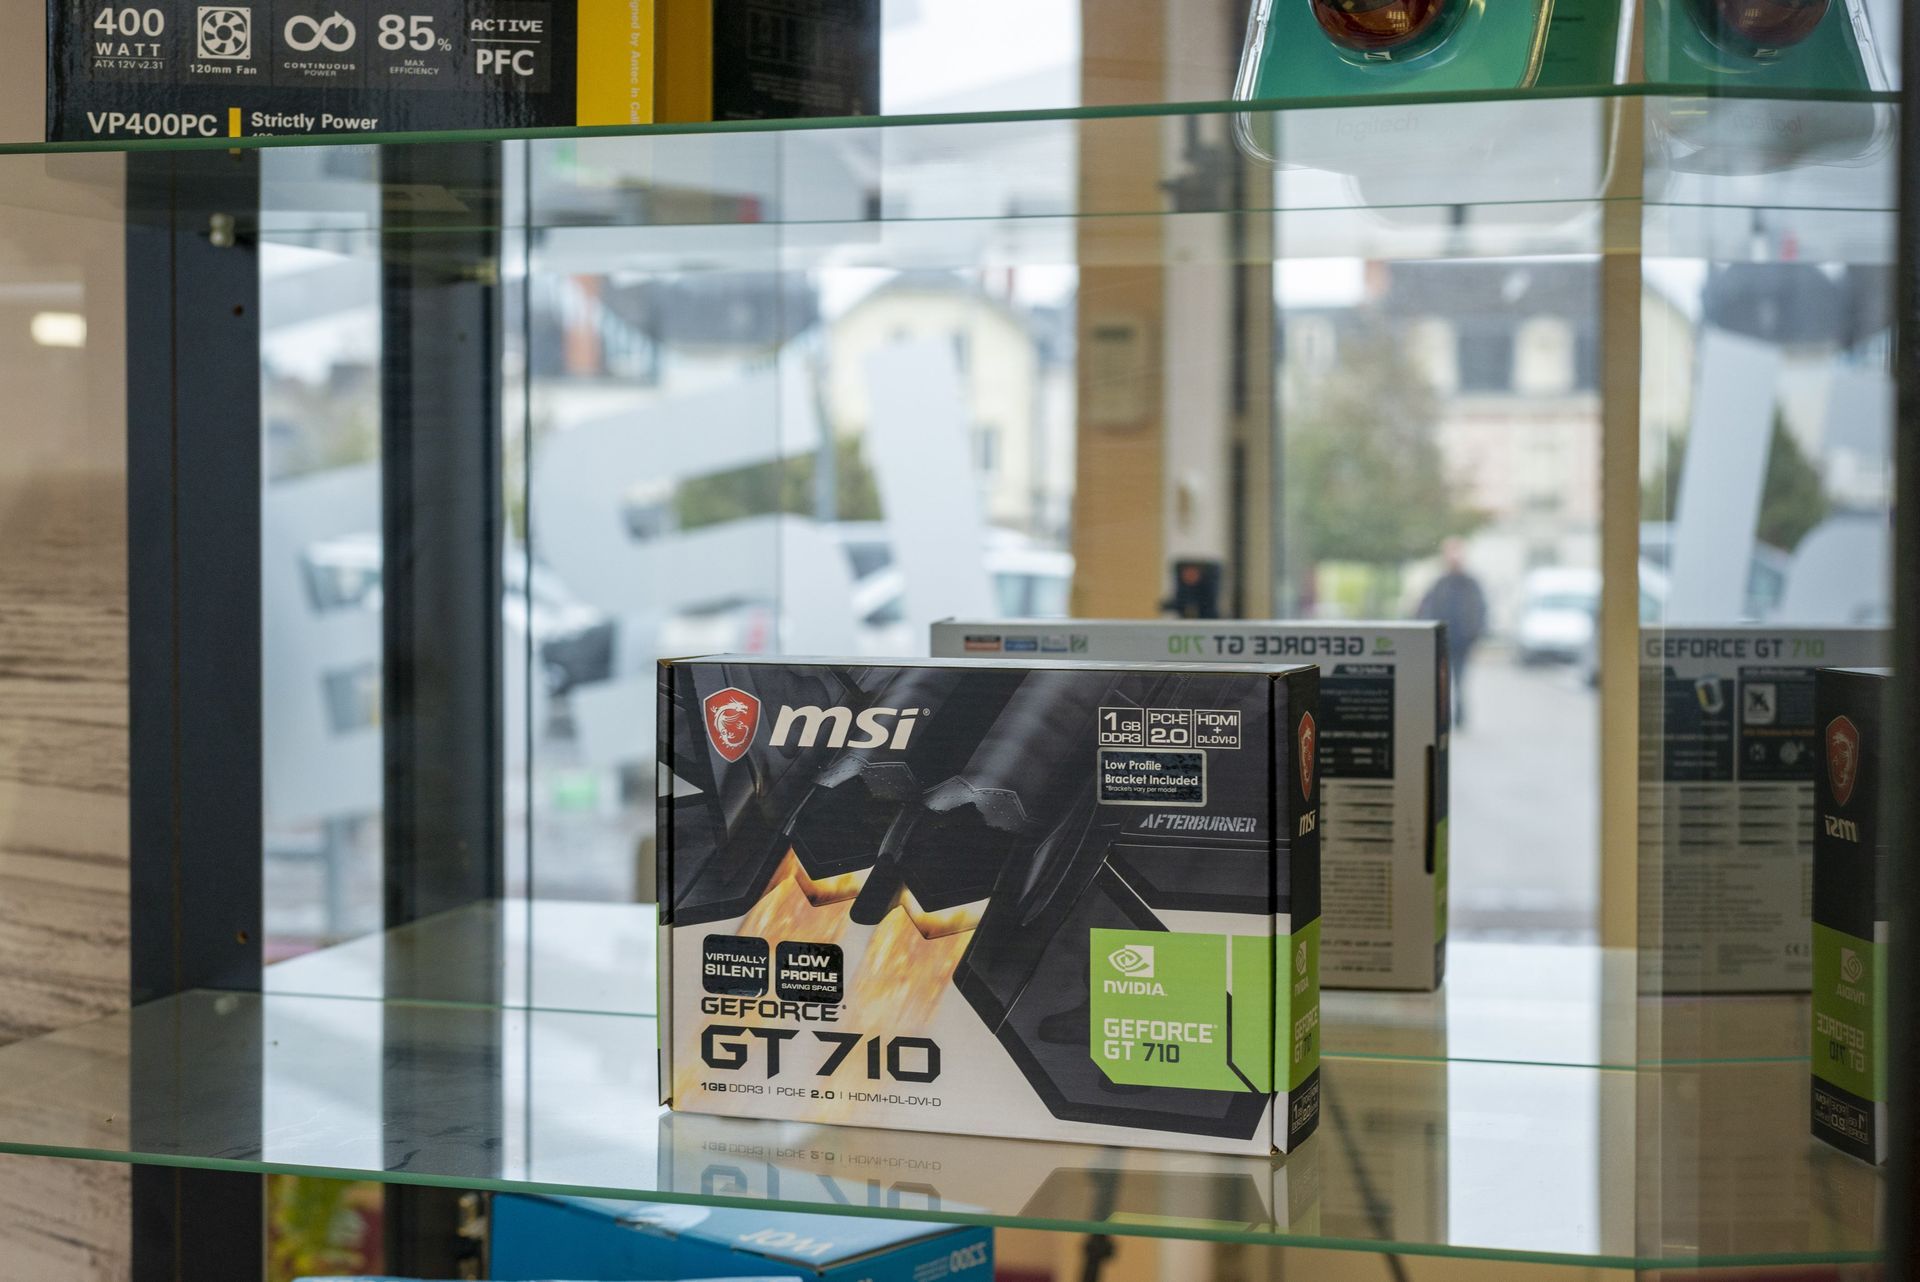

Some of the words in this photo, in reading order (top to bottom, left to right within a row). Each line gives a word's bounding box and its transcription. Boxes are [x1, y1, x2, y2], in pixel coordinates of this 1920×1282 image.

[93, 7, 165, 37] 400
[470, 18, 544, 33] ACTIVE
[630, 32, 640, 47] by
[96, 42, 161, 57] WATT
[95, 60, 115, 69] ATX
[118, 60, 136, 69] 12V
[138, 61, 164, 70] v2.31
[190, 64, 232, 74] 120mm
[236, 65, 257, 75] Fan
[283, 62, 356, 70] CONTINUOUS
[404, 59, 425, 67] MAX
[476, 49, 535, 76] PFC
[630, 50, 640, 84] Antec
[304, 69, 337, 77] POWER
[389, 66, 439, 75] EFFICIENCY
[631, 87, 640, 98] in
[86, 112, 218, 137] VP400PC
[251, 111, 316, 131] Strictly
[321, 113, 379, 130] Power
[1645, 638, 1746, 659] GEFORCE
[1755, 638, 1784, 659] GT
[1792, 639, 1825, 659] 710
[1150, 713, 1189, 725] PCI-E
[1197, 714, 1237, 726] HDMI
[769, 704, 920, 750] msi
[1101, 732, 1141, 743] DDR3
[1150, 728, 1188, 744] 2.0
[1105, 760, 1127, 770] Low
[1129, 760, 1162, 771] Profile
[1105, 773, 1147, 785] Bracket
[1149, 775, 1198, 786] Included
[1139, 813, 1257, 833] AFTERBURNER
[1299, 810, 1316, 837] msi
[706, 952, 767, 964] VIRTUALLY
[788, 953, 831, 968] LOW
[705, 963, 766, 979] SILENT
[780, 969, 838, 983] PROFILE
[781, 982, 811, 991] SAVING
[812, 984, 837, 993] SPACE
[701, 996, 840, 1023] GEFORCE
[1103, 1018, 1214, 1044] GEFORCE
[701, 1024, 800, 1080] GT
[811, 1030, 941, 1084] 710
[1103, 1040, 1135, 1061] GT
[1142, 1042, 1180, 1063] 710
[701, 1081, 727, 1092] 1GB
[728, 1083, 764, 1095] DDR3
[776, 1086, 806, 1098] PCI-E
[810, 1089, 835, 1100] 2.0
[848, 1091, 942, 1107] HDMI+DL-DVI-D
